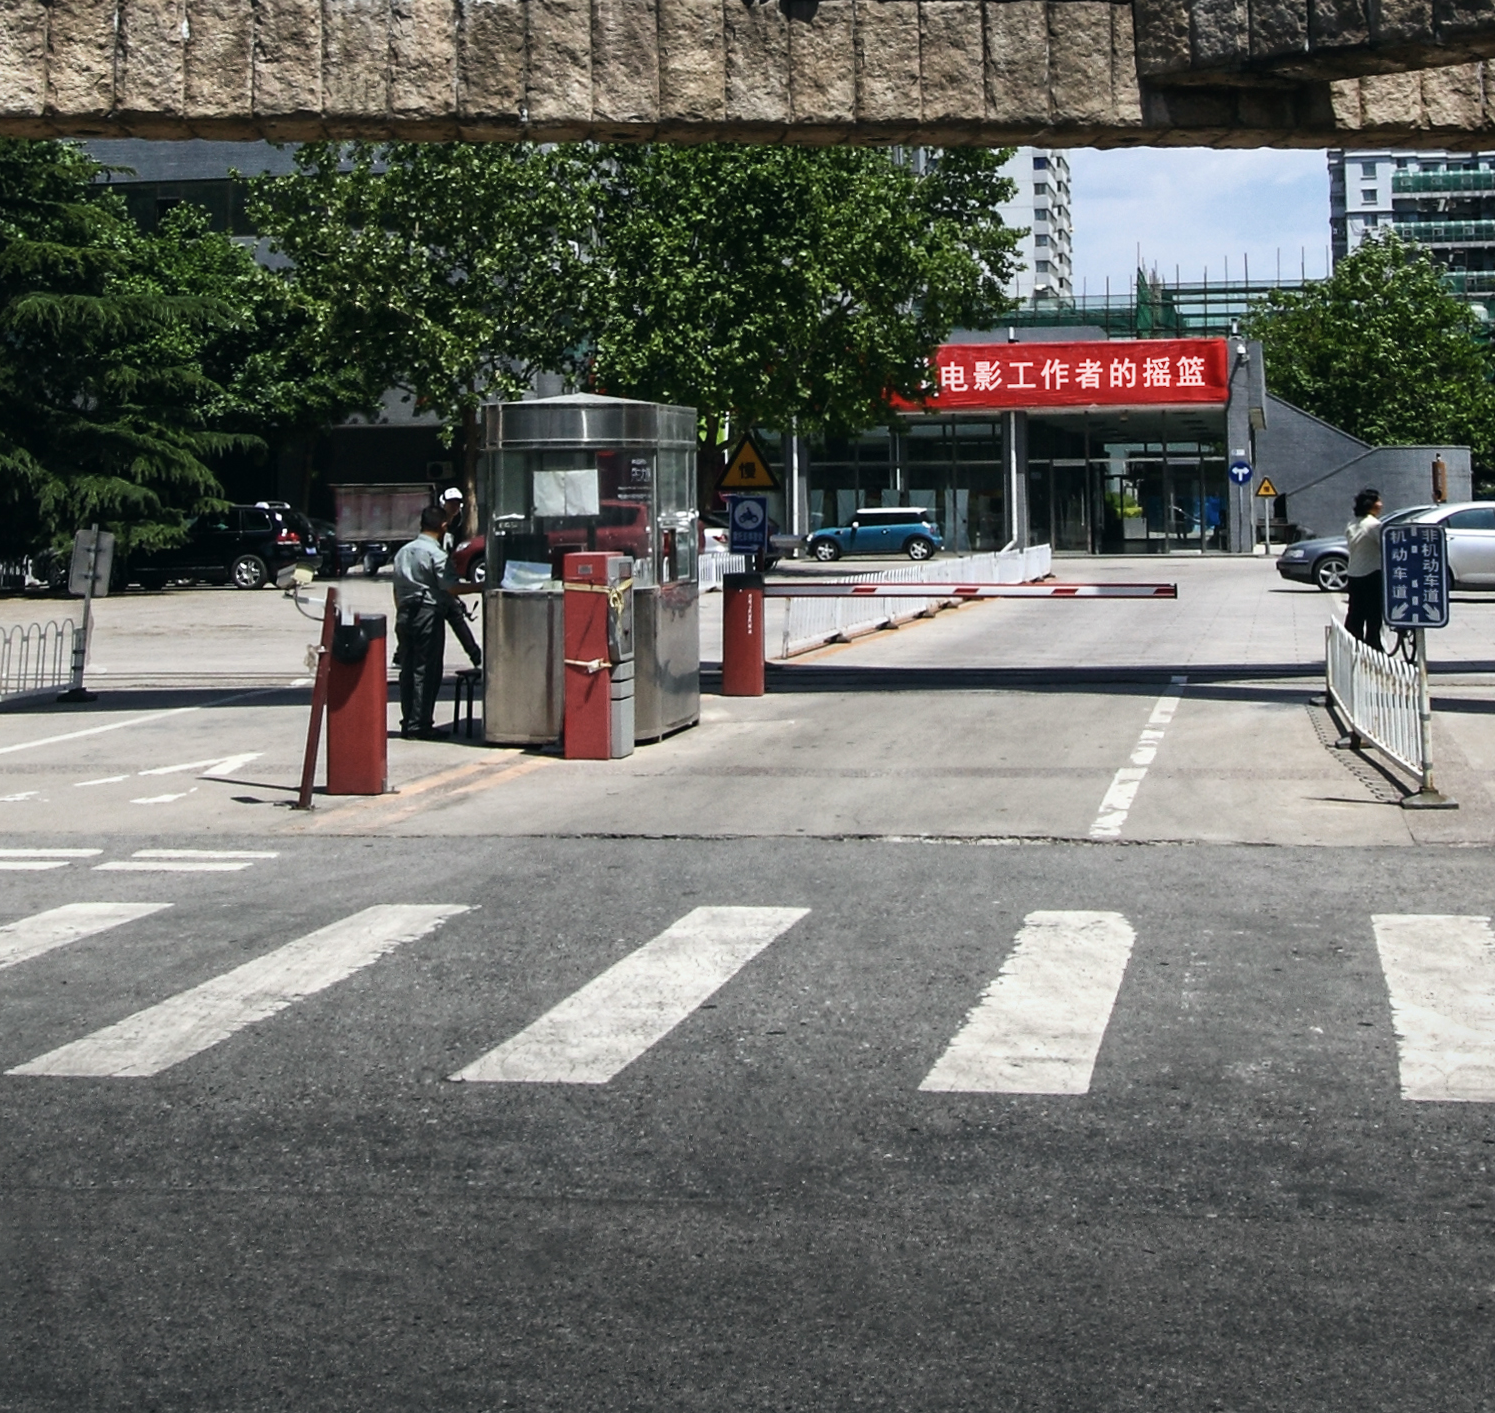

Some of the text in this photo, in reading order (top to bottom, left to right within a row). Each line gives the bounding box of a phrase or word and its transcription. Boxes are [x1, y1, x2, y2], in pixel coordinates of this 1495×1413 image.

[908, 355, 1206, 398] 电影工作者的摇篮
[738, 462, 757, 479] 慢
[1389, 530, 1408, 599] 机动车道
[1421, 529, 1440, 603] 非机动车道
